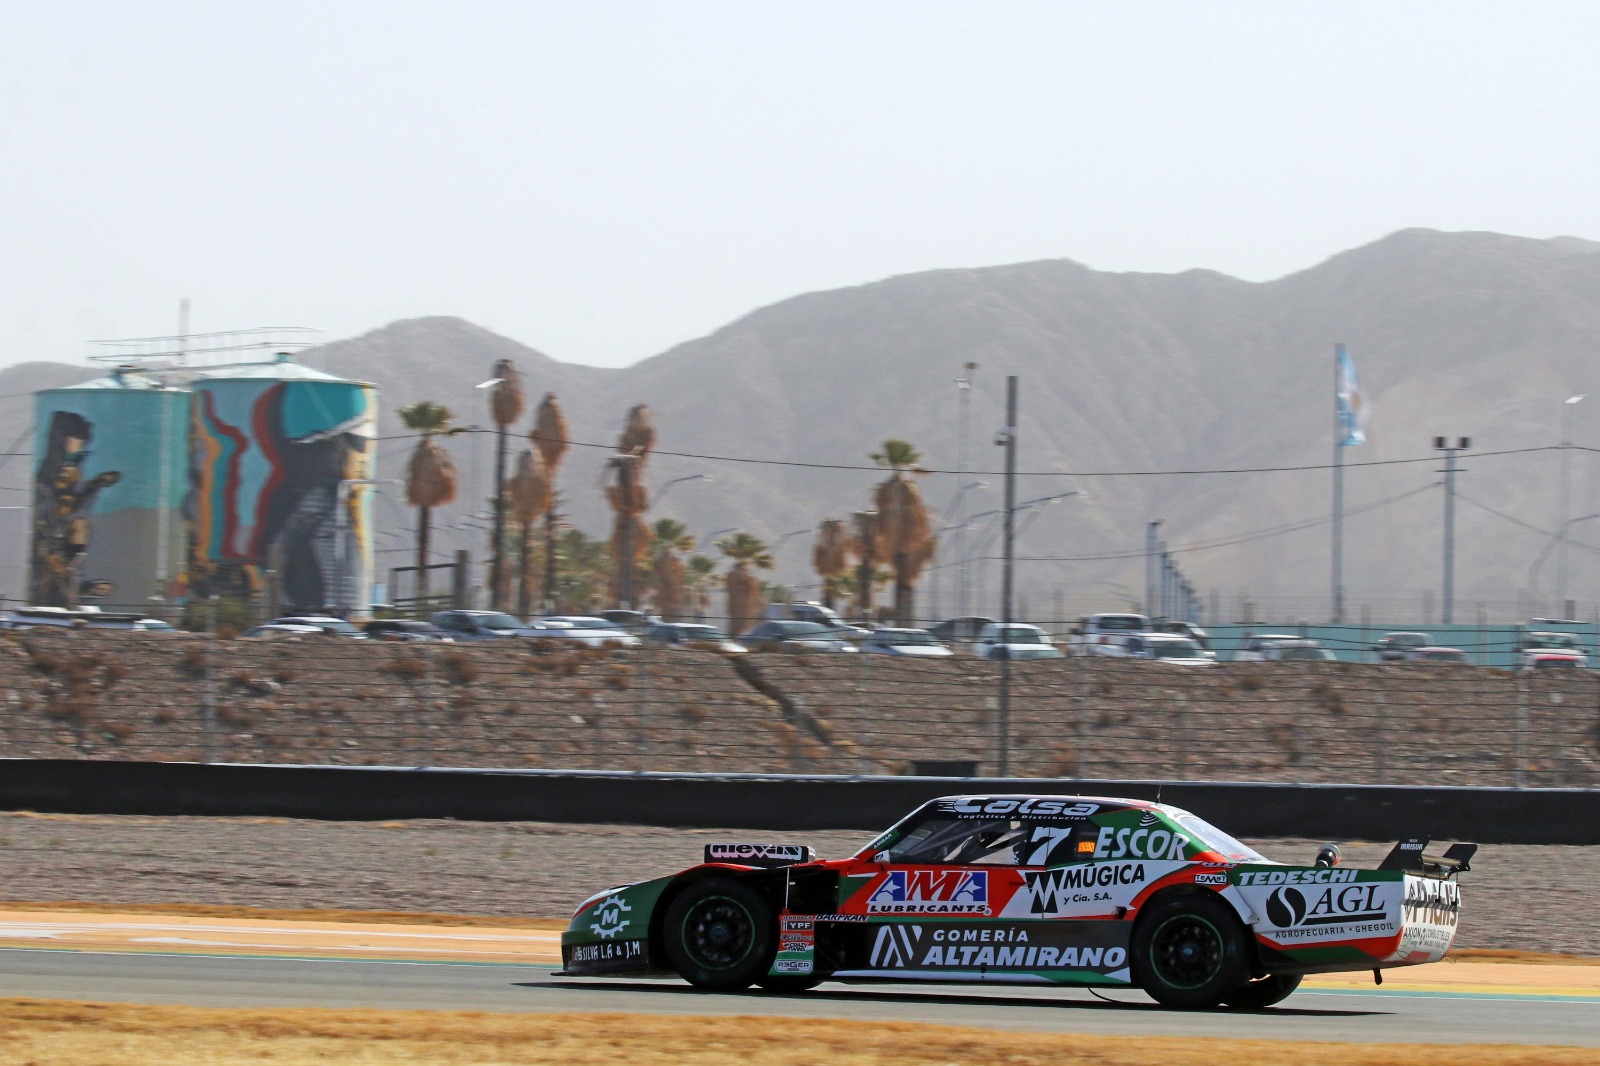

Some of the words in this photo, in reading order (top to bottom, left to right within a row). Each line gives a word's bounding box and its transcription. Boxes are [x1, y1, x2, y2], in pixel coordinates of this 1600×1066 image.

[1026, 826, 1072, 866] 7
[1093, 826, 1190, 861] ESCOR
[1063, 862, 1145, 890] MÚGICA
[1239, 869, 1358, 886] TEDESCHI
[867, 870, 989, 903] AMA
[1063, 896, 1070, 905] y
[1093, 892, 1113, 902] S.A.
[1306, 884, 1386, 915] AGL
[601, 908, 619, 925] M
[870, 904, 987, 913] LUBRICANTS
[932, 927, 1028, 943] GOMERÍA
[1275, 927, 1346, 940] AGROPECUARIA
[1355, 923, 1396, 934] GHEGOIL
[616, 946, 623, 956] &
[920, 946, 1128, 967] ALTAMIRANO
